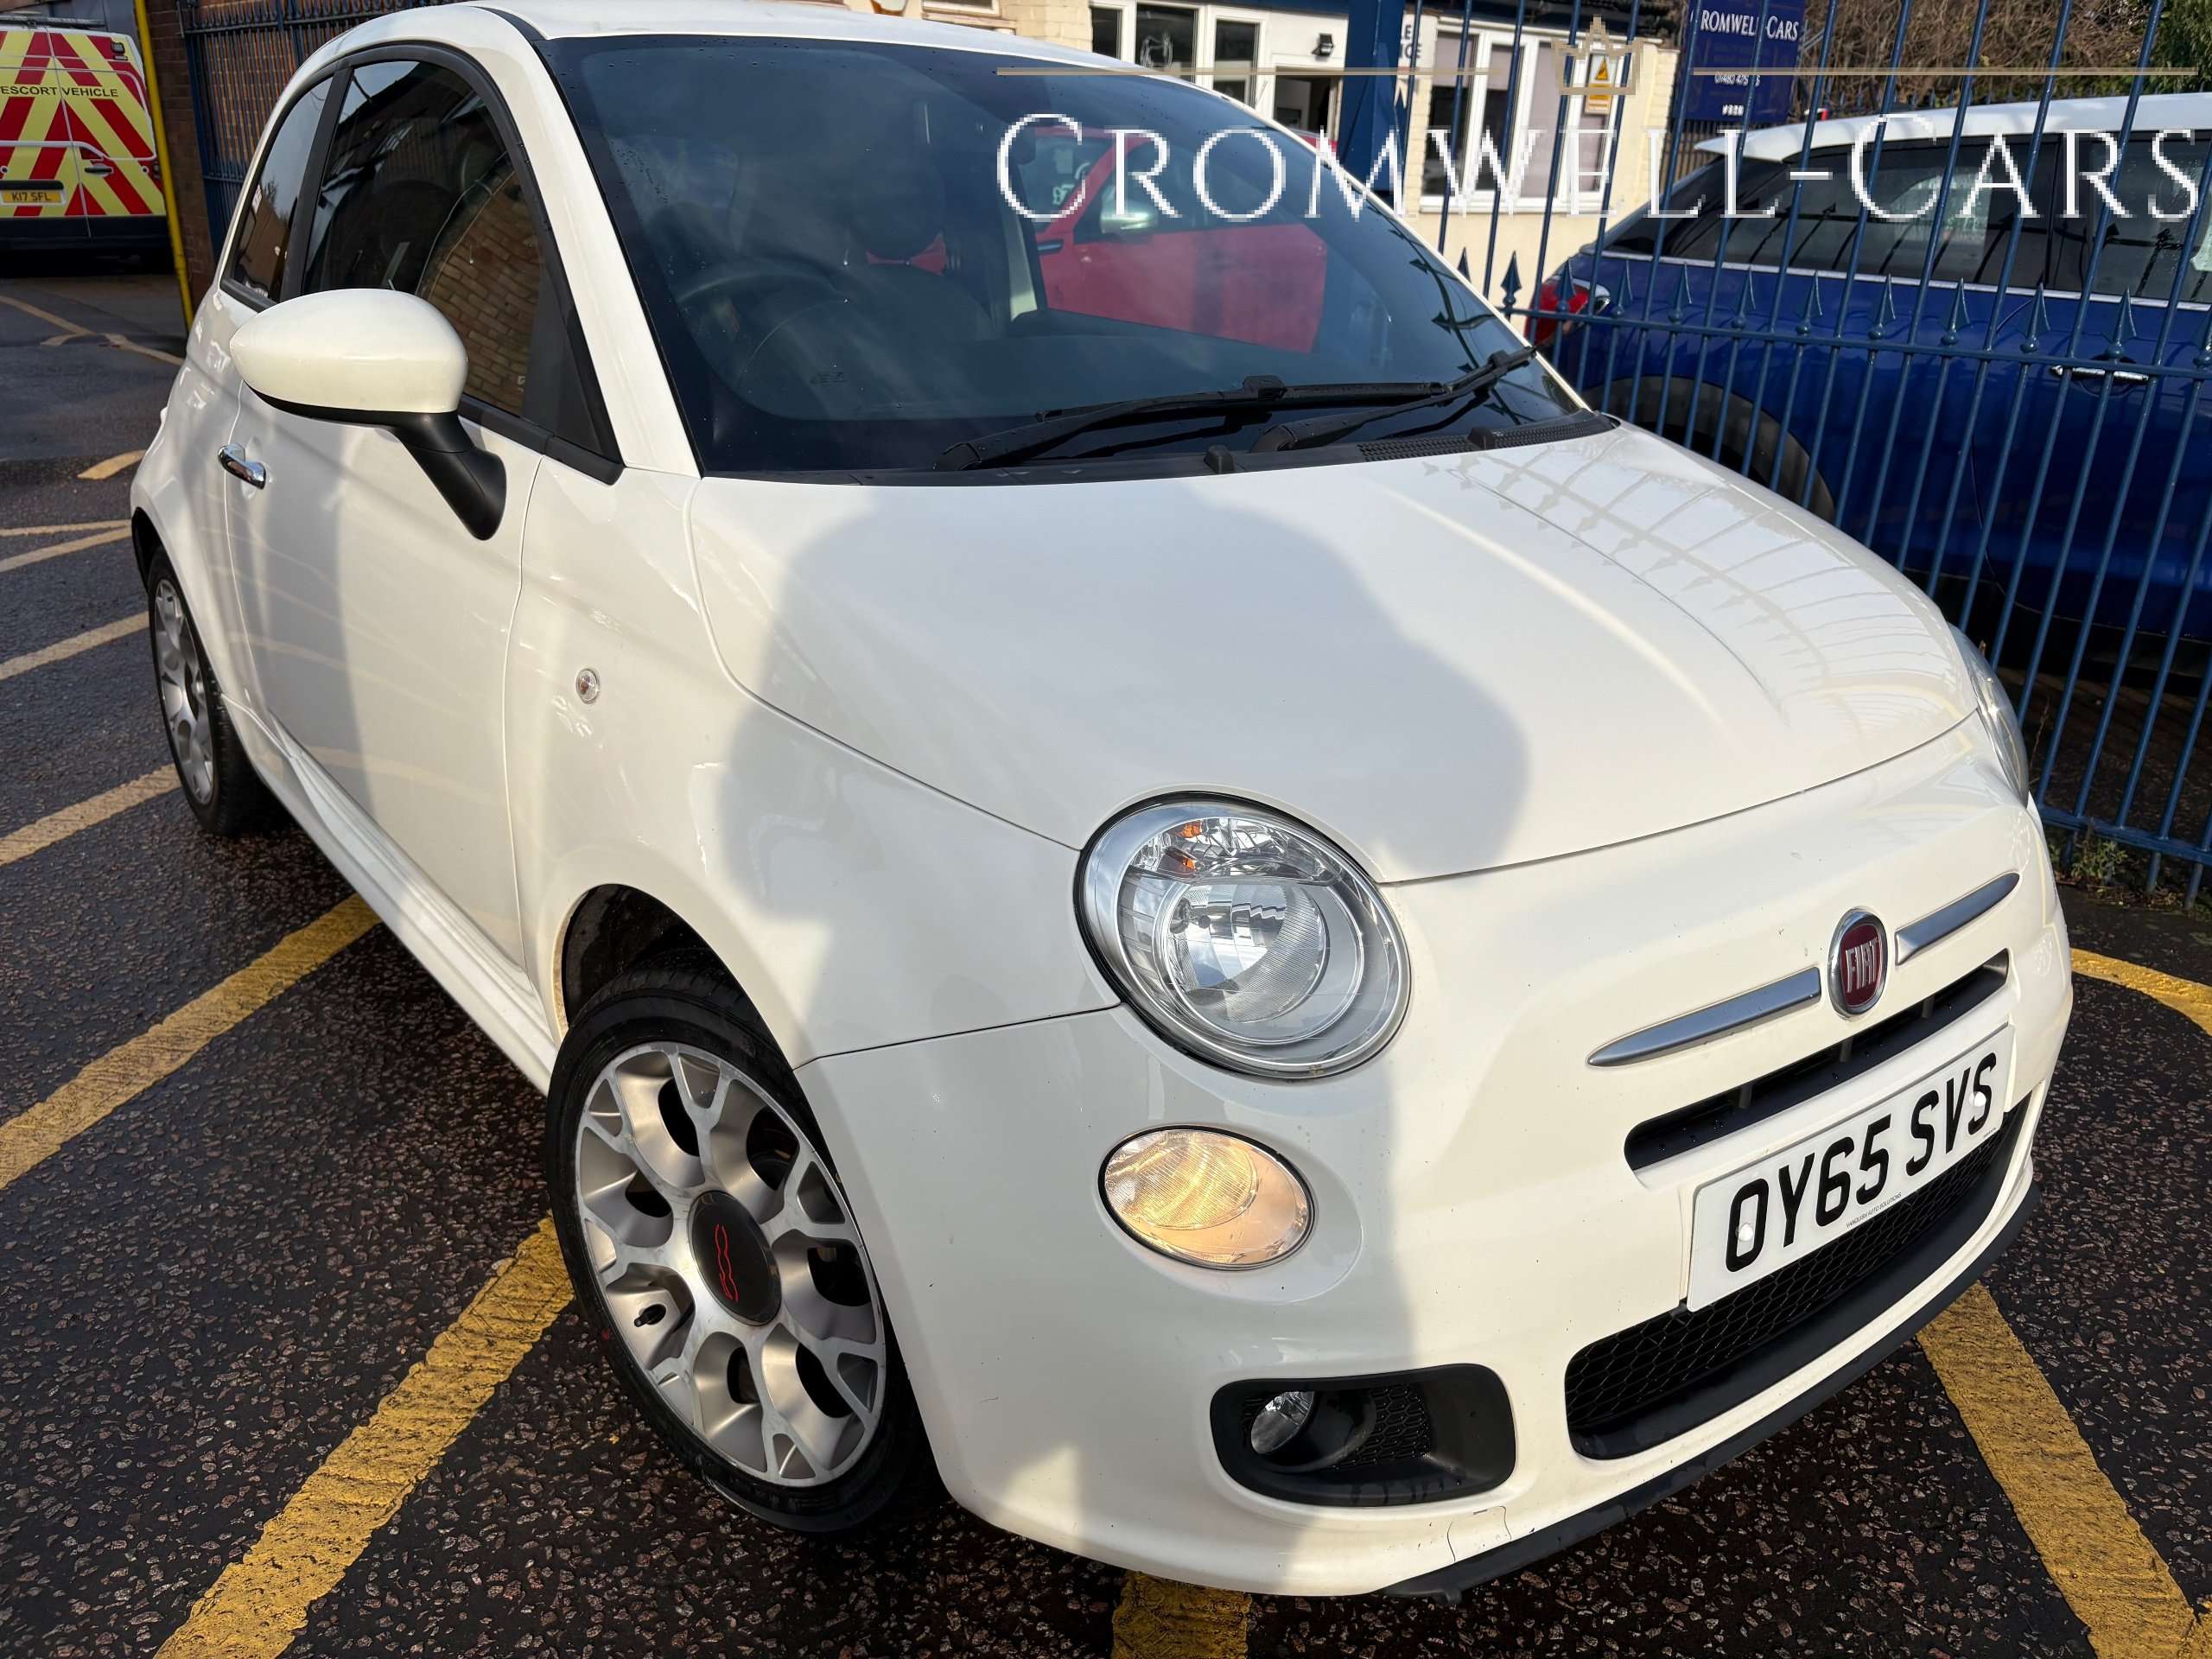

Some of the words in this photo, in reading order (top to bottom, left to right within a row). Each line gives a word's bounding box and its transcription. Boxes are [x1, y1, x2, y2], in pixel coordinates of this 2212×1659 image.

[1690, 10, 1763, 37] ROMWEL
[1, 86, 58, 96] ESCORT
[61, 87, 119, 98] VEHICLE
[12, 192, 28, 202] K17
[31, 192, 51, 201] SFL
[1845, 936, 1879, 994] FIAT
[1725, 1113, 1891, 1273] OY65
[1905, 1052, 1998, 1177] SVS
